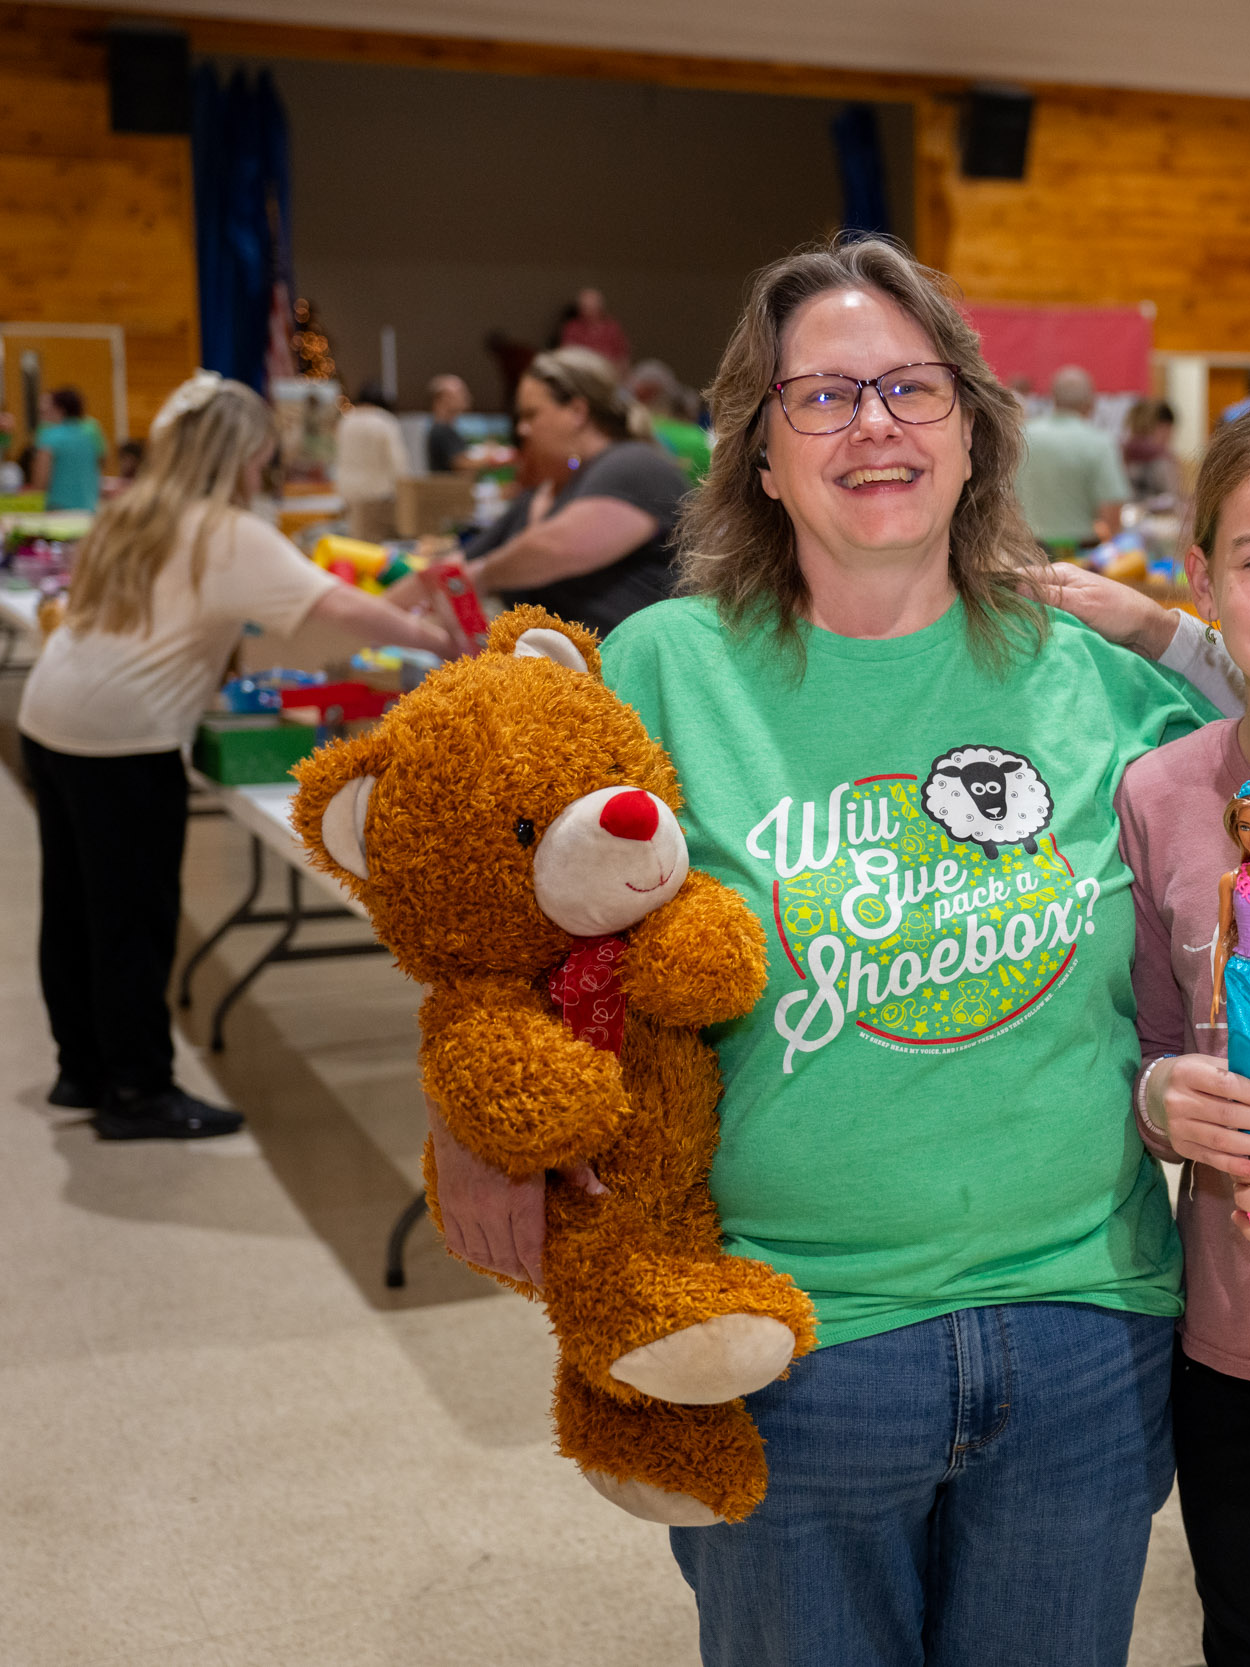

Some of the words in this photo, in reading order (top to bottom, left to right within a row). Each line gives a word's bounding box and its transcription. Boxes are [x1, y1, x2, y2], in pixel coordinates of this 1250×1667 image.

[746, 782, 900, 879] Will
[841, 848, 968, 940] Ewe
[935, 876, 1011, 930] pack
[1015, 872, 1038, 893] a
[774, 877, 1100, 1074] Shoebox?
